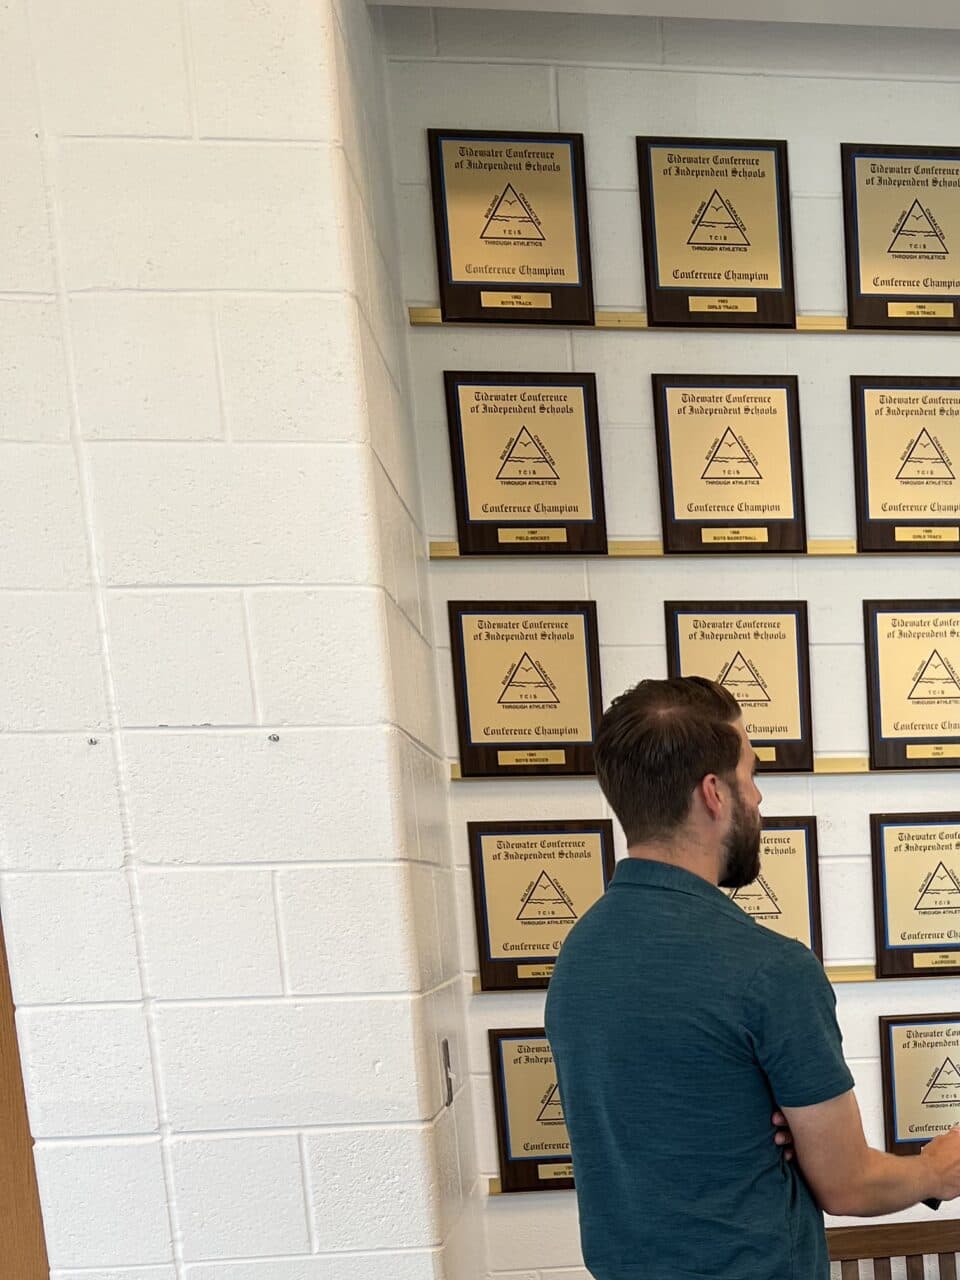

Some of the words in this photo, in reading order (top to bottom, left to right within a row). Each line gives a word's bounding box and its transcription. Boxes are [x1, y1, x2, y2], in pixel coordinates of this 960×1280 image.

[459, 146, 504, 158] Tidewater
[505, 148, 555, 159] Conference
[667, 153, 711, 165] Tidewater
[712, 155, 760, 166] Conference
[454, 160, 464, 169] of
[466, 159, 522, 172] Independent
[525, 161, 561, 173] Schools
[870, 164, 912, 174] Tidewater
[914, 165, 960, 176] Conference
[663, 166, 672, 176] of
[674, 166, 728, 179] Independent
[731, 167, 766, 180] Schools
[866, 176, 875, 185] of
[876, 176, 929, 188] Independent
[484, 195, 500, 219] BUILDING
[519, 193, 542, 227] CHARACTER
[691, 201, 706, 225] BUILDING
[725, 199, 747, 232] CHARACTER
[892, 210, 907, 234] BUILDING
[925, 208, 946, 241] CHARACTER
[465, 263, 516, 275] Conference
[519, 264, 565, 278] Champion
[672, 269, 722, 280] Conference
[724, 270, 769, 282] Champion
[873, 277, 920, 287] Conference
[474, 392, 518, 402] Tidewater
[520, 392, 568, 402] Conference
[681, 393, 724, 403] Tidewater
[725, 394, 772, 403] Conference
[879, 395, 920, 404] Tidewater
[470, 404, 480, 413] of
[481, 404, 536, 415] Independent
[539, 404, 574, 415] Schools
[677, 406, 686, 414] of
[688, 405, 741, 416] Independent
[744, 405, 777, 416] Schools
[875, 407, 883, 415] of
[885, 407, 936, 417] Independent
[500, 437, 515, 461] BUILDING
[534, 435, 556, 466] CHARACTER
[482, 503, 531, 513] Conference
[534, 503, 579, 514] Champion
[687, 502, 735, 512] Conference
[737, 502, 781, 513] Champion
[881, 502, 927, 512] Conference
[477, 620, 520, 629] Tidewater
[522, 620, 569, 629] Conference
[891, 618, 931, 628] Tidewater
[473, 632, 483, 640] of
[484, 631, 537, 642] Independent
[540, 631, 575, 642] Schools
[887, 630, 895, 638] of
[897, 629, 947, 640] Independent
[483, 726, 532, 736] Conference
[534, 725, 579, 737] Champion
[893, 721, 939, 731] Conference
[898, 831, 937, 841] Tidewater
[894, 844, 902, 852] of
[904, 842, 952, 853] Independent
[918, 872, 932, 893] BUILDING
[901, 930, 944, 941] Conference
[906, 1029, 944, 1039] Tidewater
[902, 1041, 910, 1049] of
[912, 1038, 959, 1050] Independent
